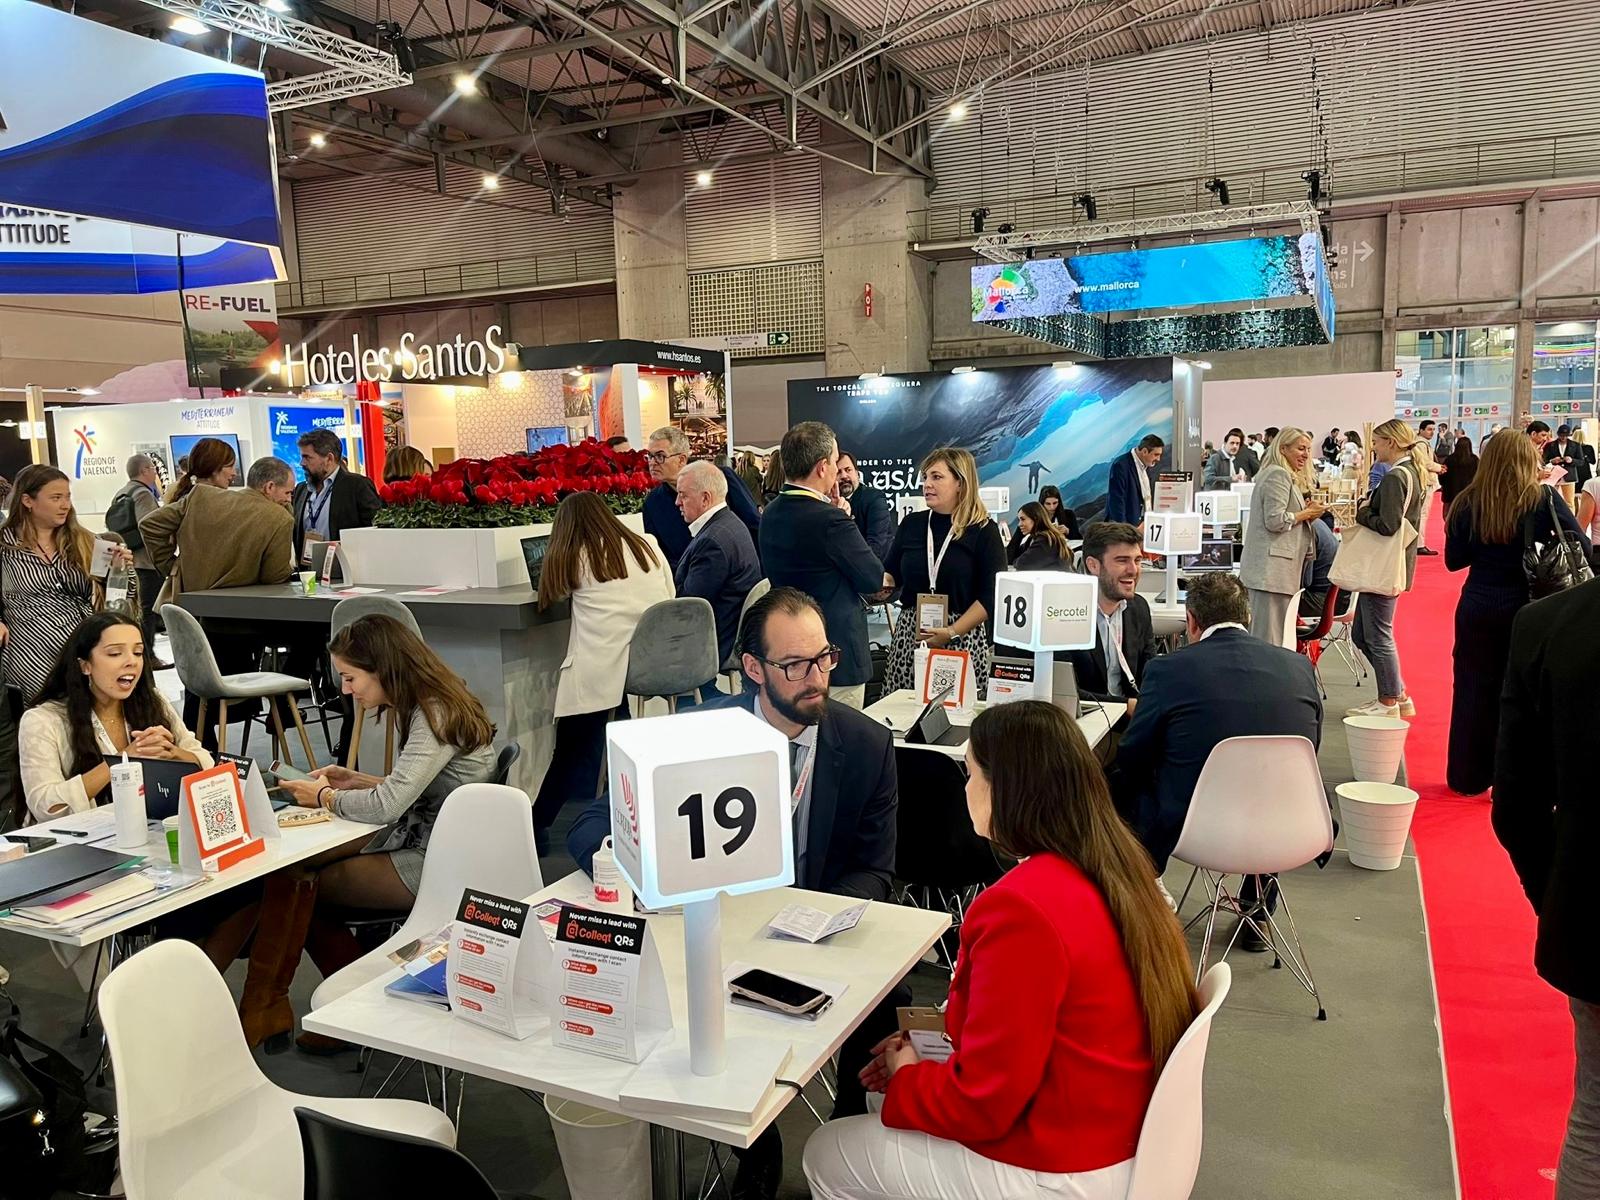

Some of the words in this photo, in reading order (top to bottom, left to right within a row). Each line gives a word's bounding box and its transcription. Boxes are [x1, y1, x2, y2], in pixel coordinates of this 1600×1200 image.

[1074, 280, 1140, 294] www.mallorca
[185, 294, 271, 313] RE-FUEL
[285, 333, 392, 388] Hoteles
[656, 350, 702, 364] www.hsantos.es
[181, 406, 234, 421] MEDITERRANEAN
[83, 457, 105, 466] REGION
[107, 456, 116, 465] OF
[83, 466, 118, 476] VALENCIA
[1200, 502, 1211, 516] 16
[1150, 524, 1162, 542] 17
[1004, 594, 1027, 628] 18
[1046, 605, 1088, 618] Sercotel
[678, 786, 757, 860] 19
[469, 894, 483, 904] Never
[484, 898, 495, 908] miss
[500, 903, 510, 912] lead
[510, 906, 522, 914] with
[475, 910, 500, 926] Colleqt
[501, 918, 518, 930] QRs
[569, 912, 587, 922] Never
[588, 916, 602, 924] miss
[608, 918, 622, 927] lead
[622, 920, 637, 930] with
[580, 928, 612, 944] Colleqt
[614, 934, 634, 946] QRs
[588, 951, 610, 960] exchange
